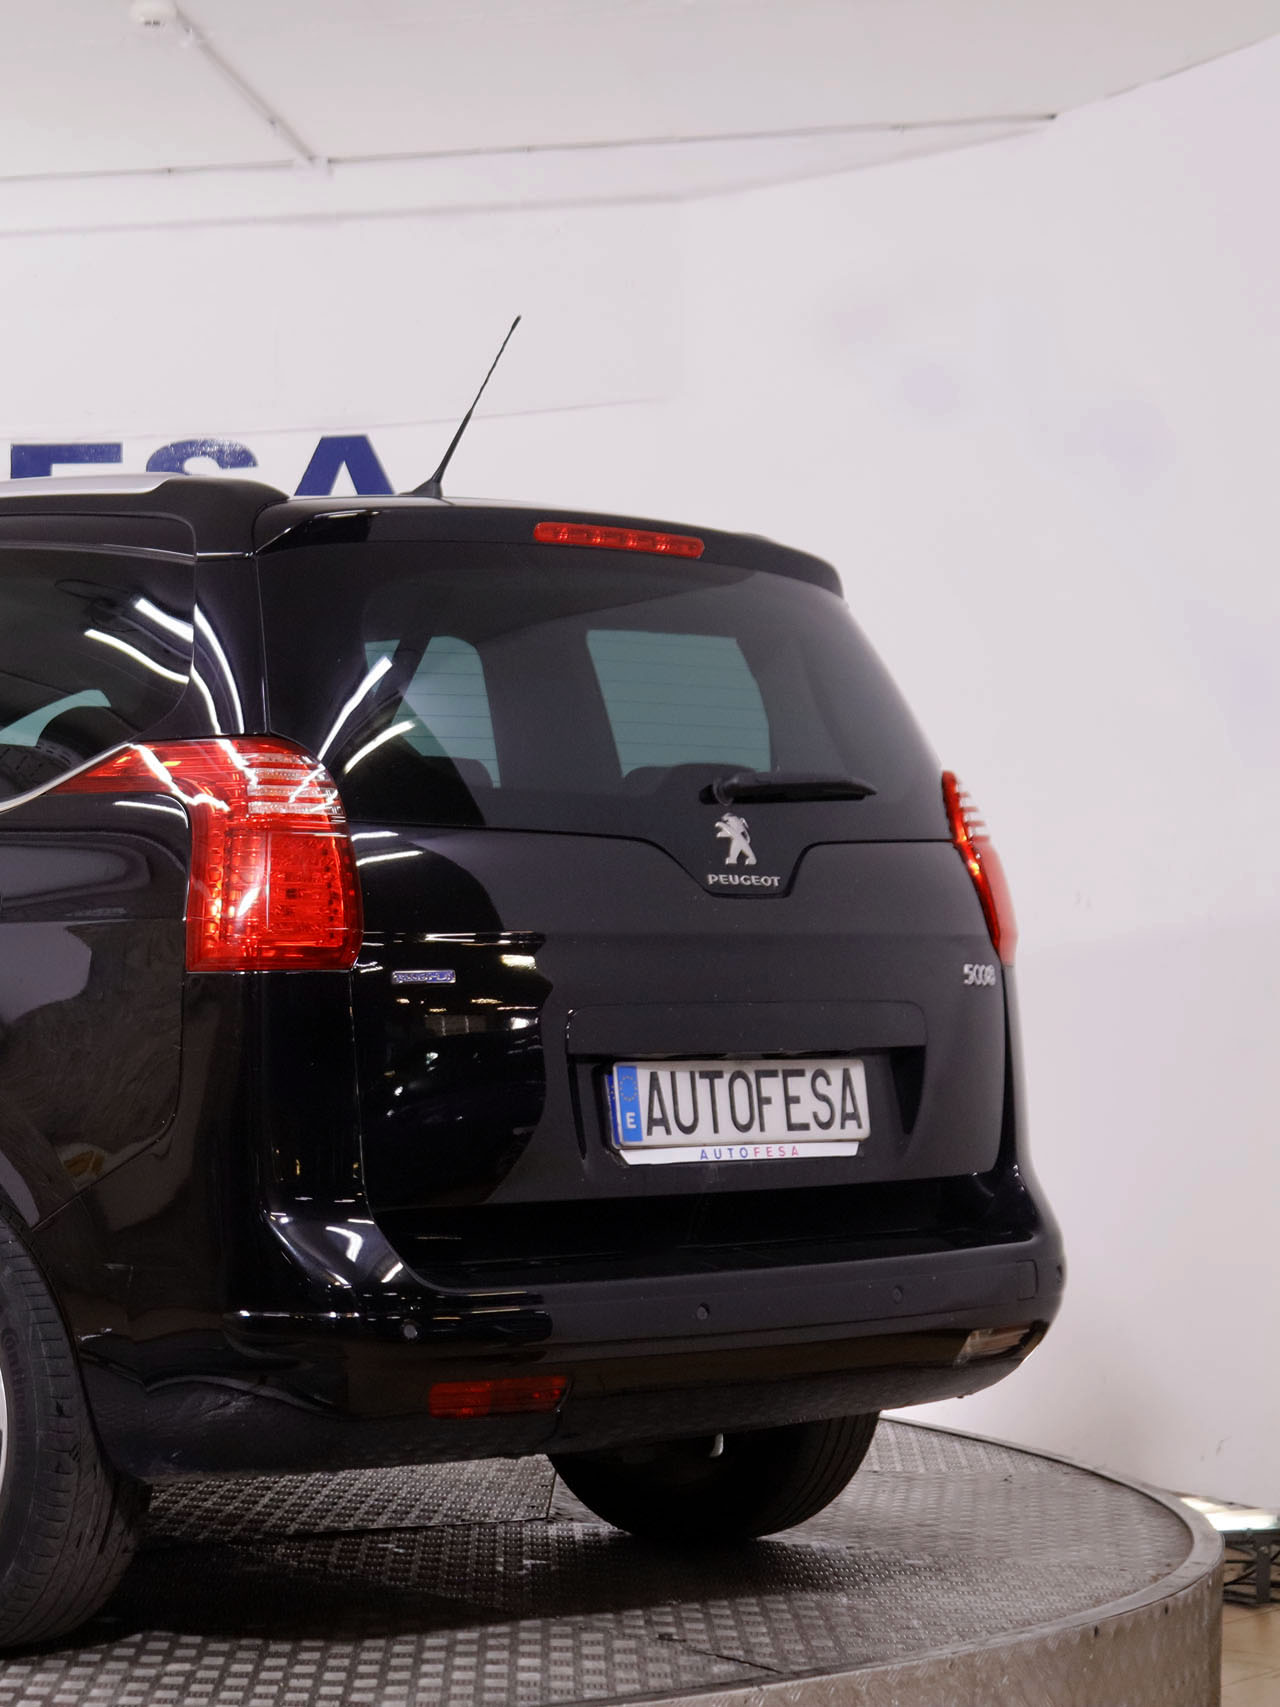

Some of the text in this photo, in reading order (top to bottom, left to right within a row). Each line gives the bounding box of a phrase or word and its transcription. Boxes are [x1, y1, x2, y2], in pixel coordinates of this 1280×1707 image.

[707, 874, 781, 887] PEUGEOT
[626, 1067, 863, 1136] E AUTOFESA
[699, 1145, 799, 1161] AUTOFESA
